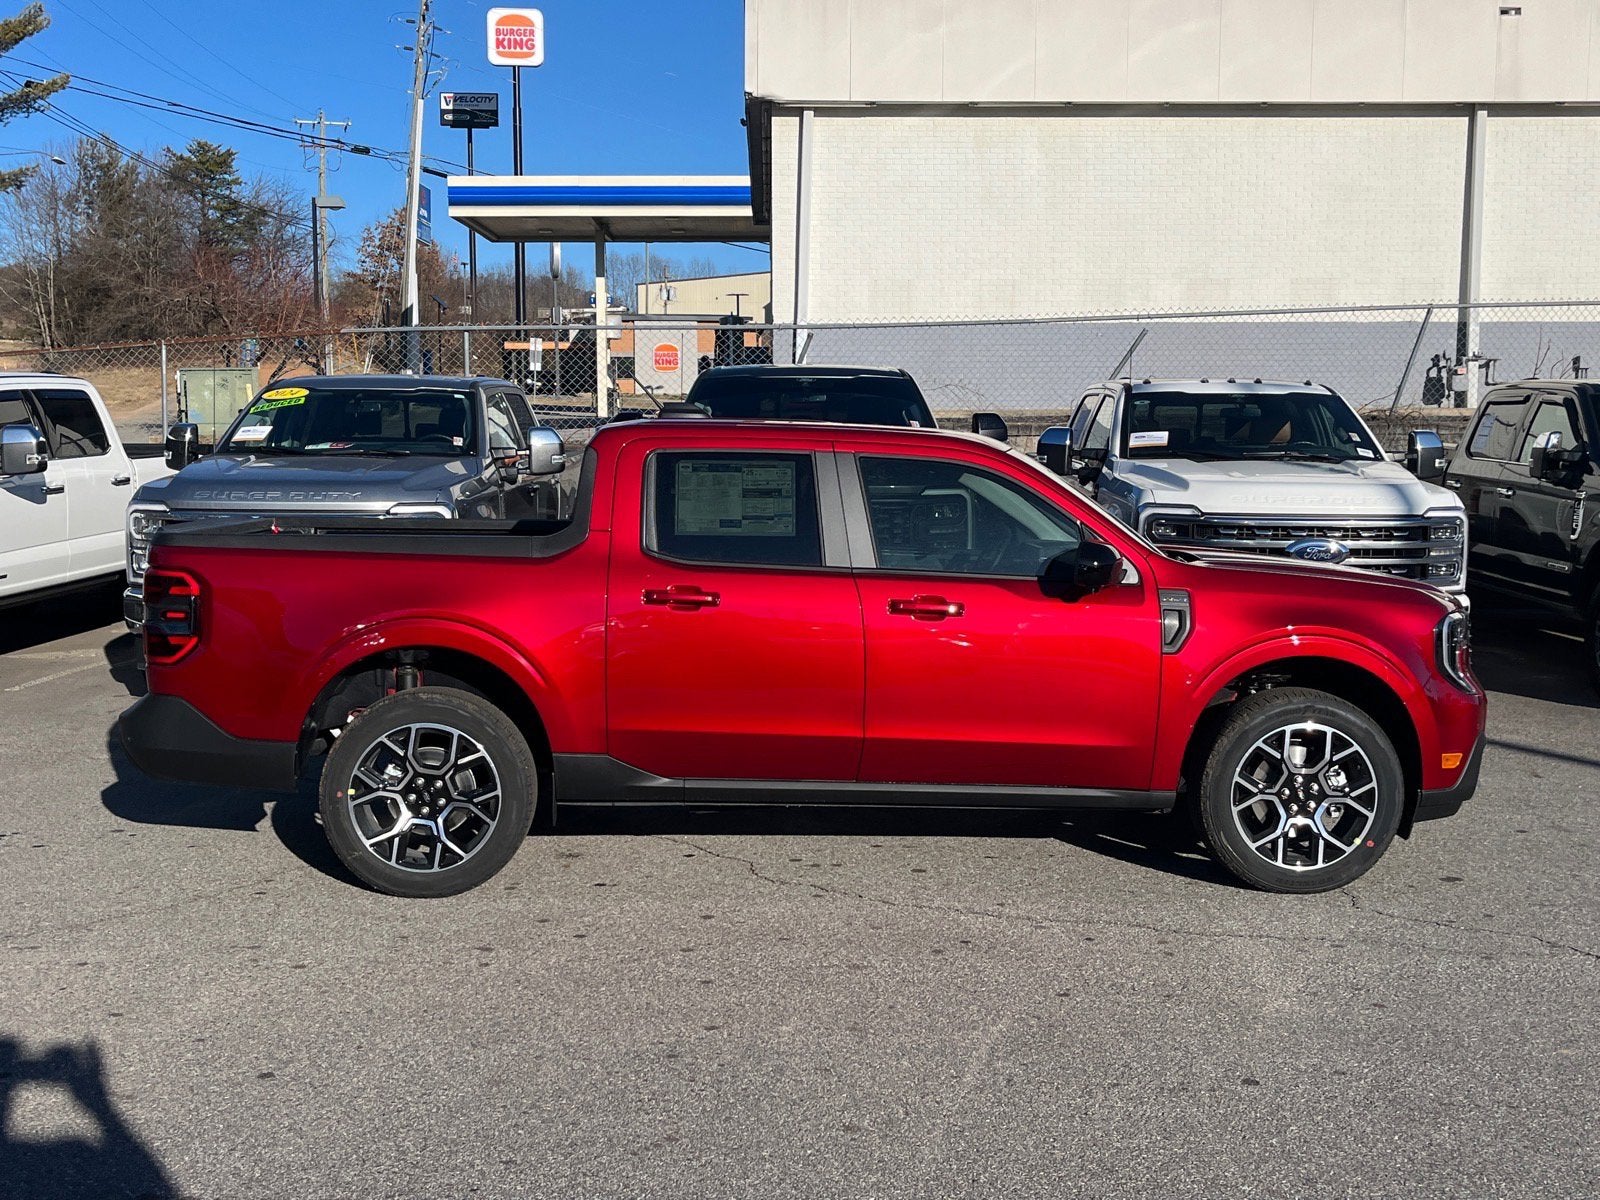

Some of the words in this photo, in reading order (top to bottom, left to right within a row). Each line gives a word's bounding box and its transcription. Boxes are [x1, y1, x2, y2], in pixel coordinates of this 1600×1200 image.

[495, 28, 535, 38] BURGER
[495, 38, 535, 50] KING
[254, 398, 302, 410] REDUCED
[194, 490, 280, 500] SUPER
[289, 492, 362, 500] DUTY
[1304, 546, 1332, 560] Ford
